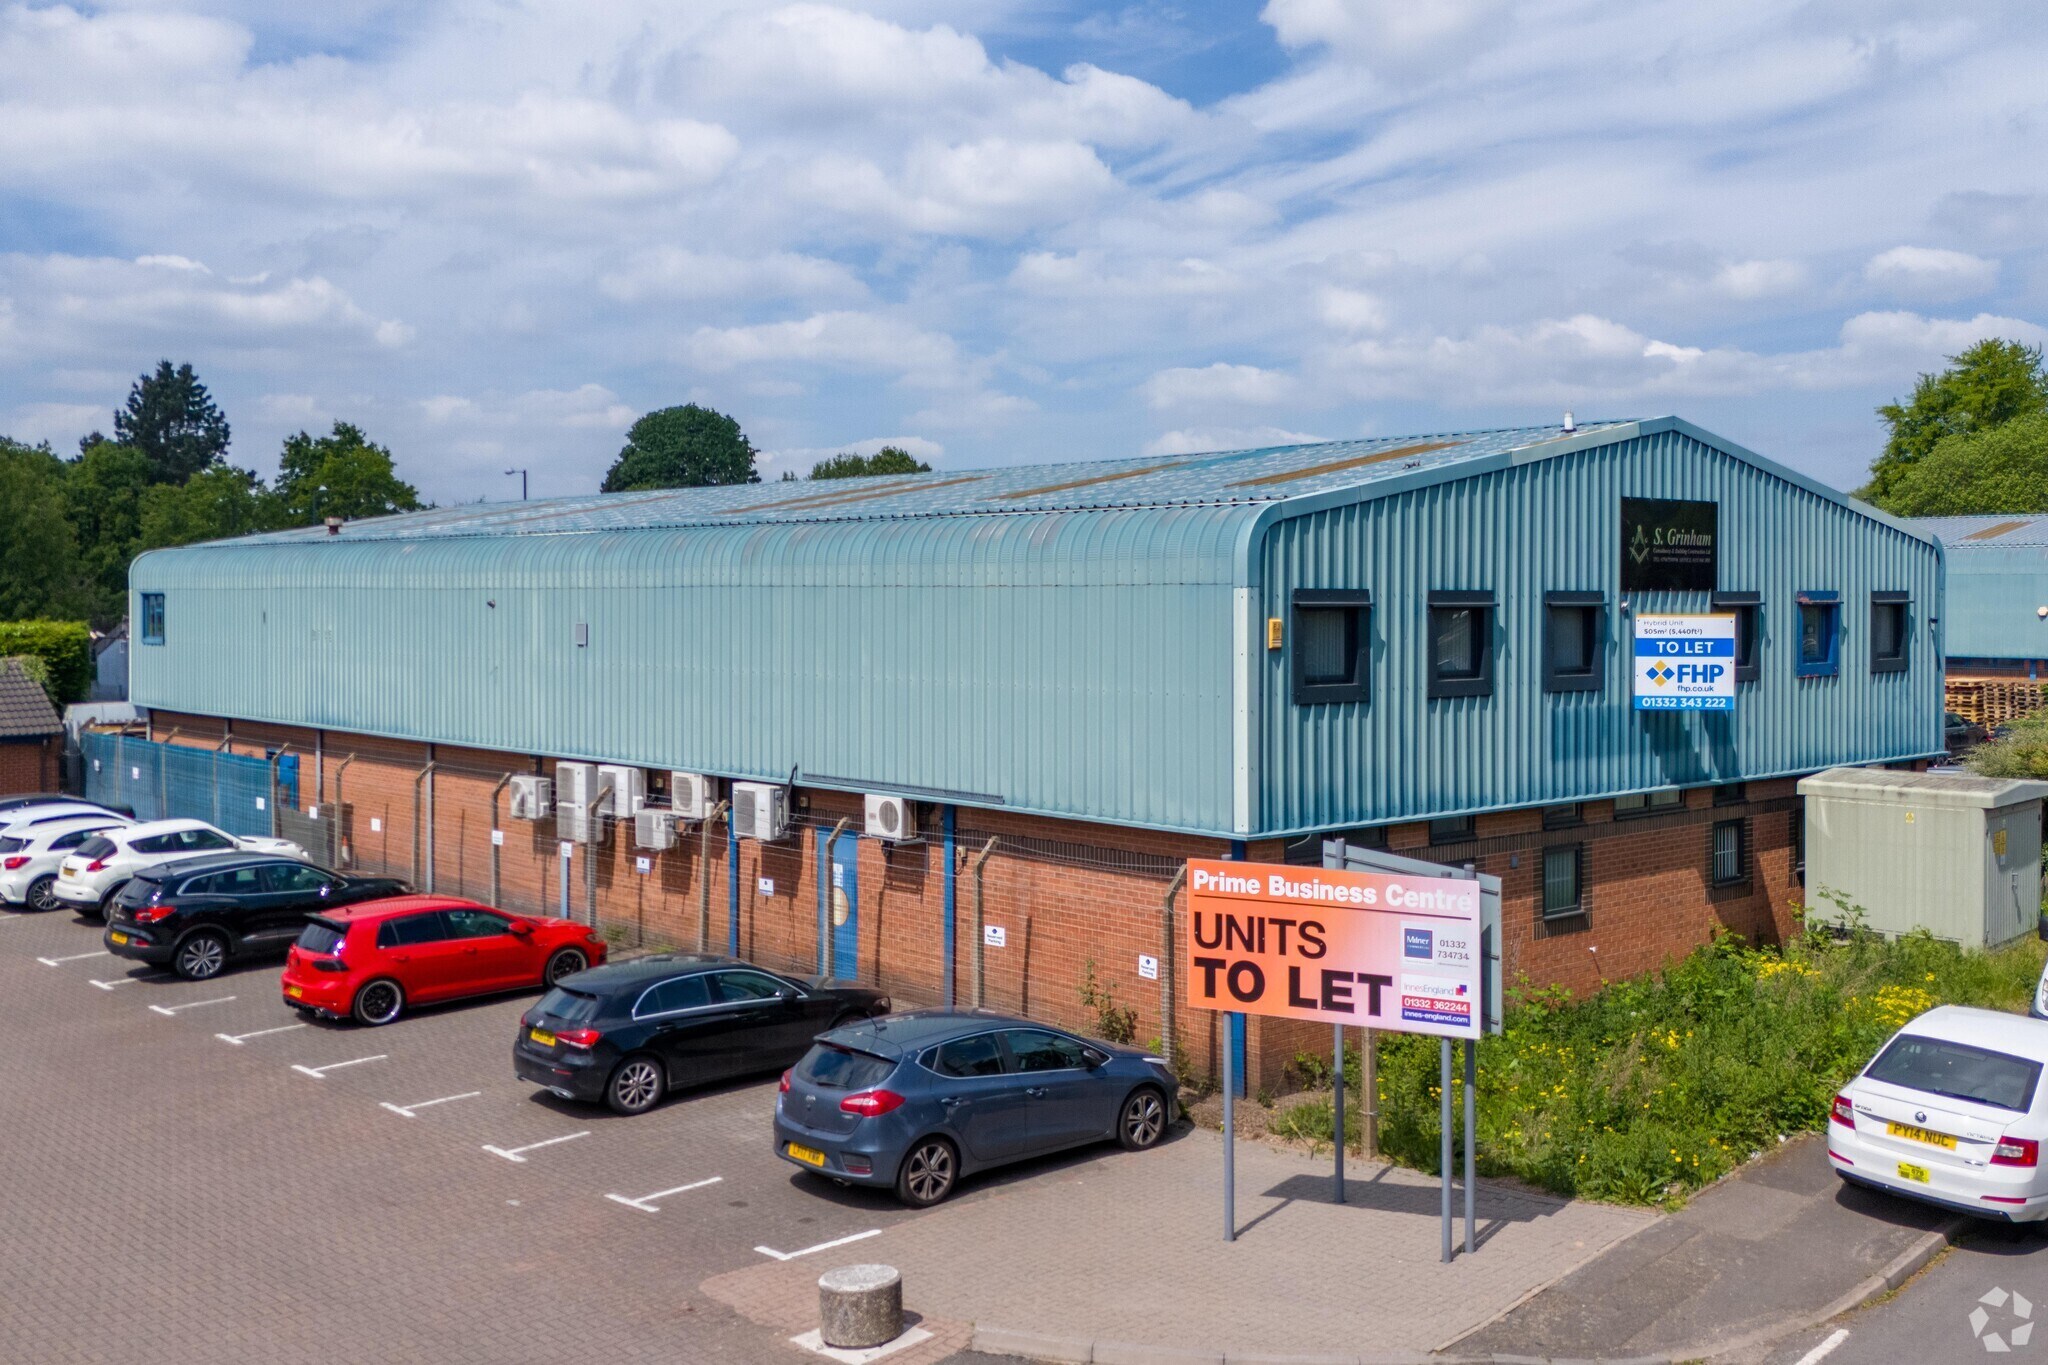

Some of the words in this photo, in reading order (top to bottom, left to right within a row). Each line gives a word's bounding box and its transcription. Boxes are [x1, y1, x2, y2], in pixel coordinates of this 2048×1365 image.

[1653, 527, 1664, 545] S.
[1667, 528, 1712, 546] Grinham
[1656, 641, 1679, 654] TO
[1684, 641, 1714, 654] LET
[1677, 664, 1725, 684] FHP
[1677, 685, 1714, 693] fhp.co.uk
[1642, 697, 1677, 708] 01332
[1680, 697, 1702, 708] 343
[1704, 697, 1726, 708] 222
[1193, 869, 1261, 895] Prime
[1268, 875, 1378, 904] Business
[1385, 883, 1473, 912] Centre
[1194, 911, 1327, 959] UNITS
[1439, 939, 1466, 949] 01332
[1437, 950, 1470, 960] 734734
[1194, 956, 1266, 1003] TO
[1288, 965, 1393, 1017] LET
[1404, 998, 1431, 1009] 01332
[1433, 1000, 1468, 1013] 362244
[1404, 1010, 1469, 1023] innes-england.com
[1893, 1123, 1920, 1140] PY14
[1924, 1131, 1950, 1147] NUC
